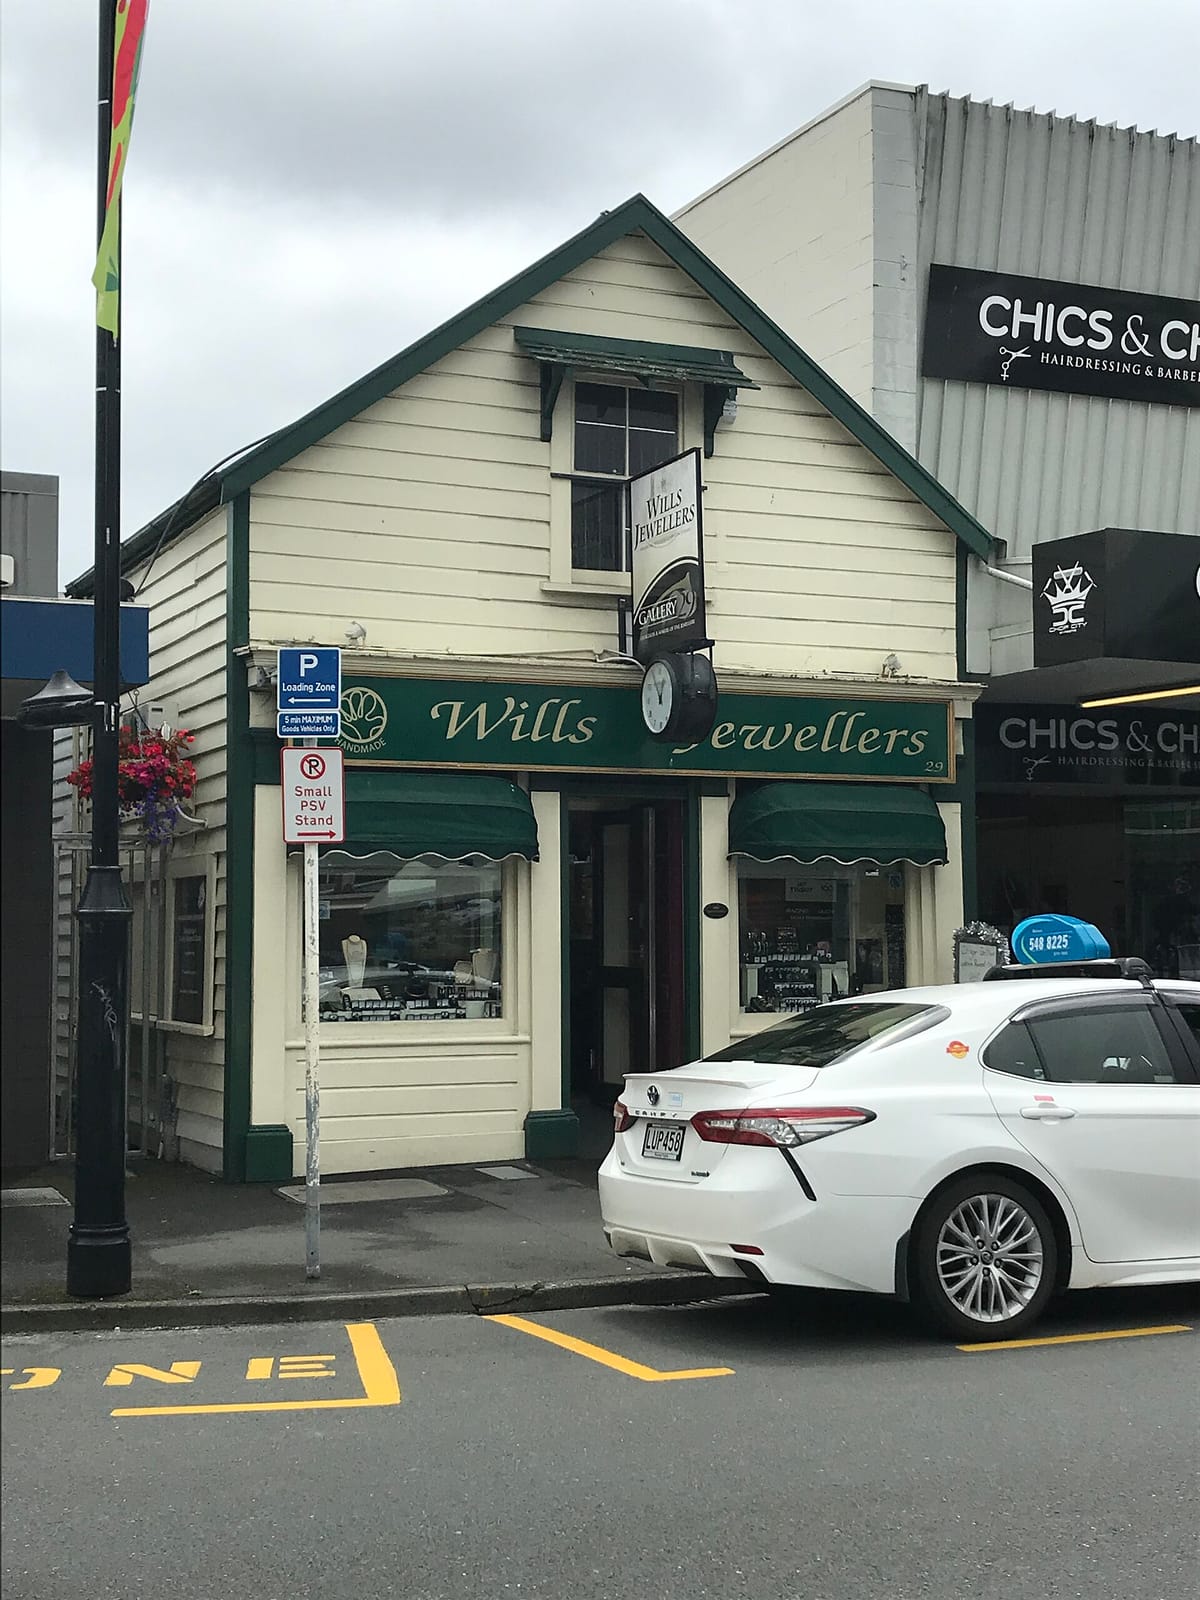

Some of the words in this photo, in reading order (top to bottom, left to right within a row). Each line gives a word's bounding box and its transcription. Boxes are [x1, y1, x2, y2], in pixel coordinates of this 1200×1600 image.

[979, 295, 1114, 350] CHICS
[1120, 314, 1154, 357] &
[1040, 352, 1141, 377] HAIRDRESSING
[1144, 365, 1154, 377] &
[646, 488, 682, 520] WILLS
[634, 503, 695, 551] JEWELLERS
[638, 599, 677, 625] GALLERY
[299, 653, 319, 677] P
[282, 682, 313, 693] Loading
[315, 682, 336, 692] Zone
[284, 715, 290, 724] 5
[290, 715, 300, 723] min
[301, 715, 333, 723] MAXIMUM
[430, 696, 598, 744] Wills
[672, 711, 929, 757] ewellers
[322, 724, 335, 733] Only
[999, 717, 1119, 750] CHICS
[1125, 720, 1153, 752] &
[1156, 722, 1200, 755] CH
[334, 737, 387, 753] HANDMADE
[925, 760, 944, 773] 29
[1057, 756, 1145, 767] HAIRDRESSING
[294, 785, 333, 797] Small
[300, 800, 326, 812] PSV
[295, 814, 333, 826] Stand
[1029, 936, 1044, 951] 548
[1046, 934, 1069, 950] 8225
[645, 1129, 681, 1152] LUP458
